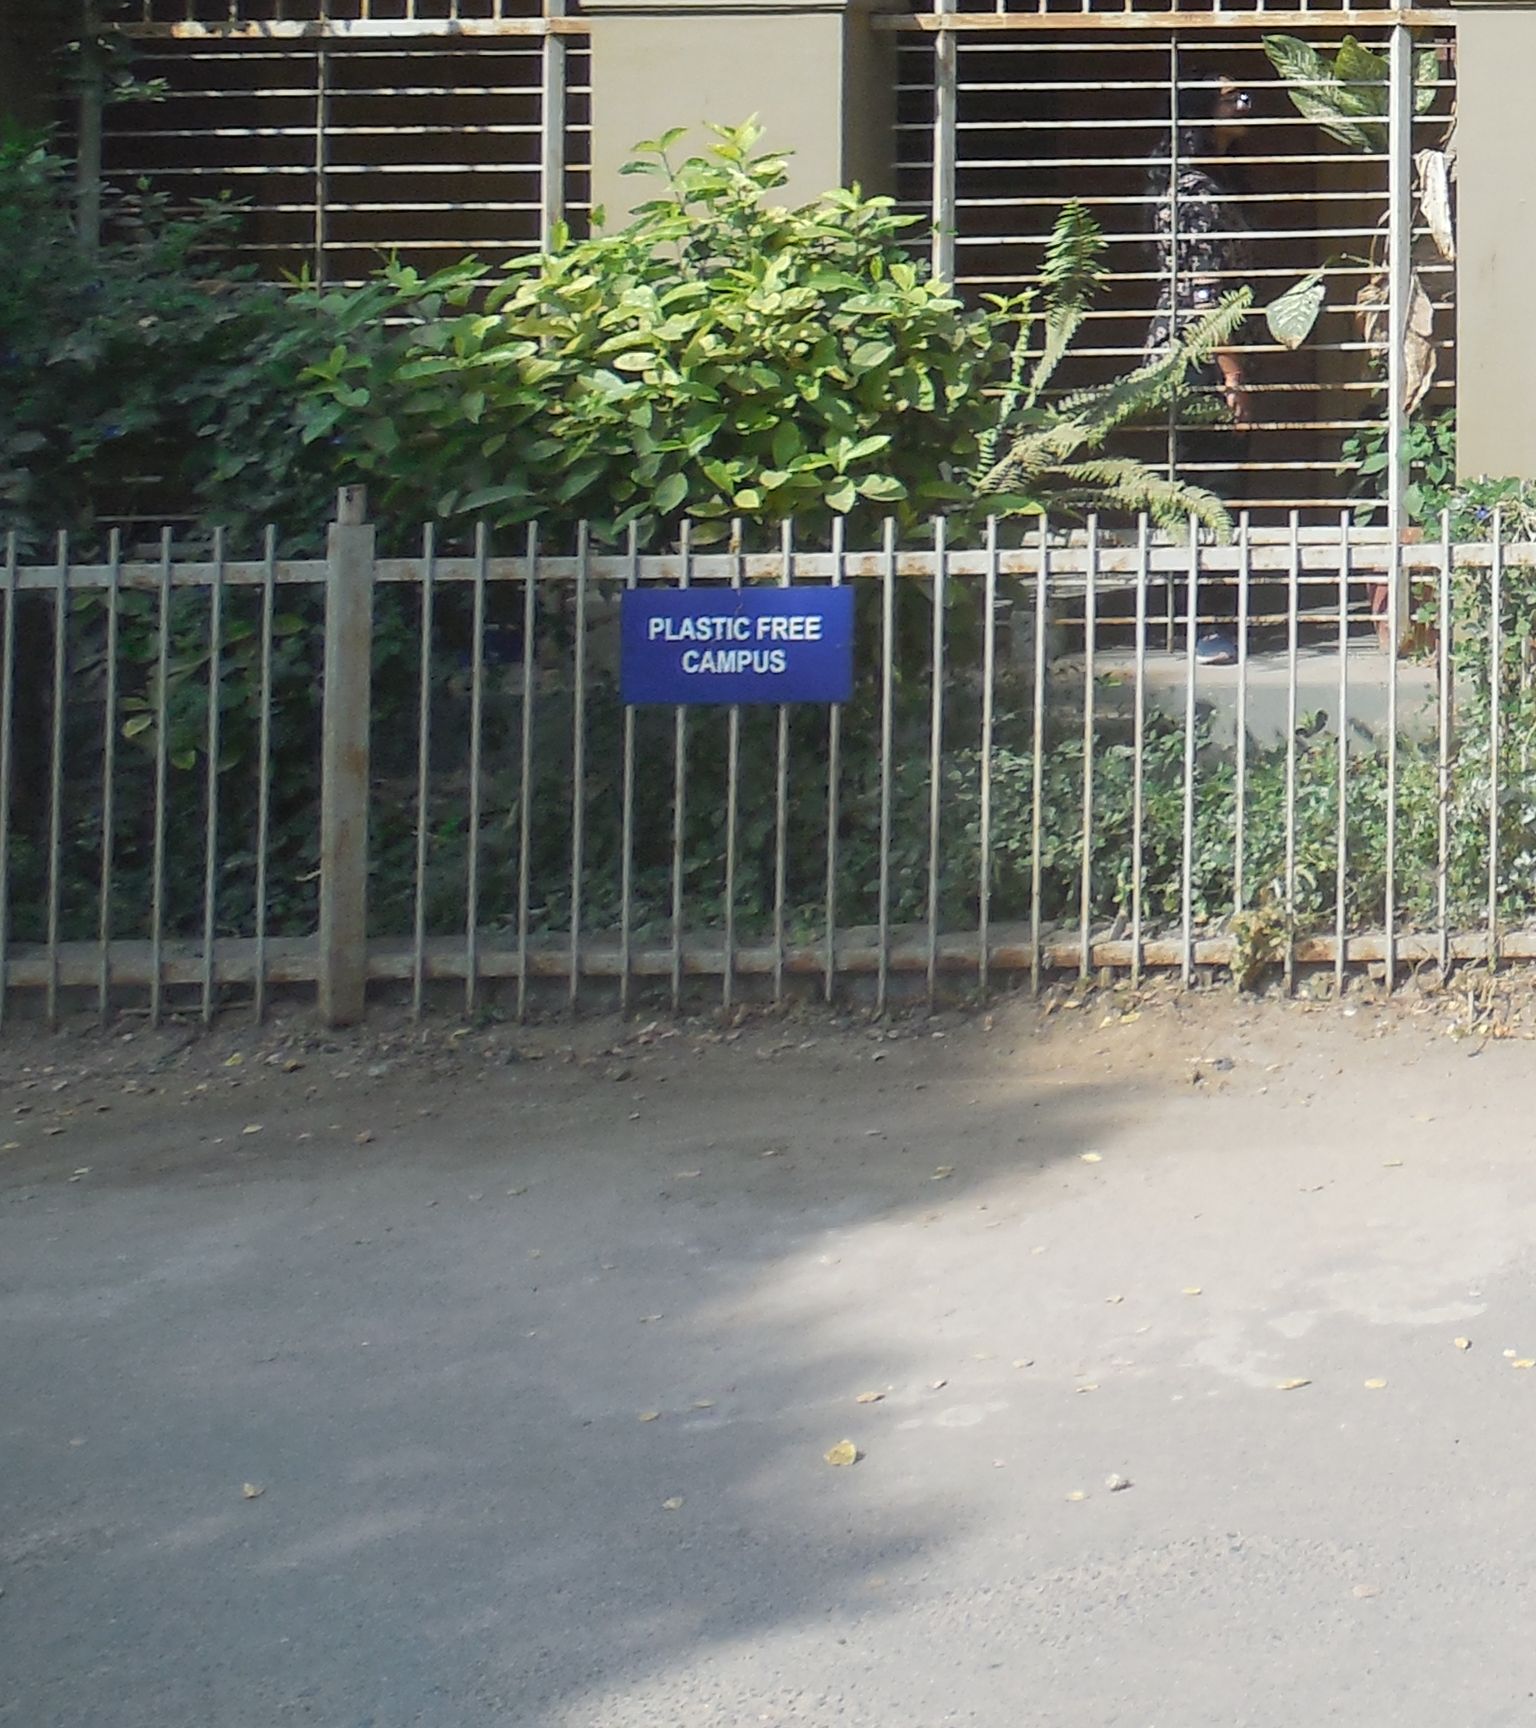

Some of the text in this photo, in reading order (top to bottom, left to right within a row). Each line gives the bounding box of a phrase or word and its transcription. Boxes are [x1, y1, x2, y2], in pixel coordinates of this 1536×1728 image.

[648, 616, 823, 641] PLASTIC FREE
[681, 649, 787, 674] CAMPUS
